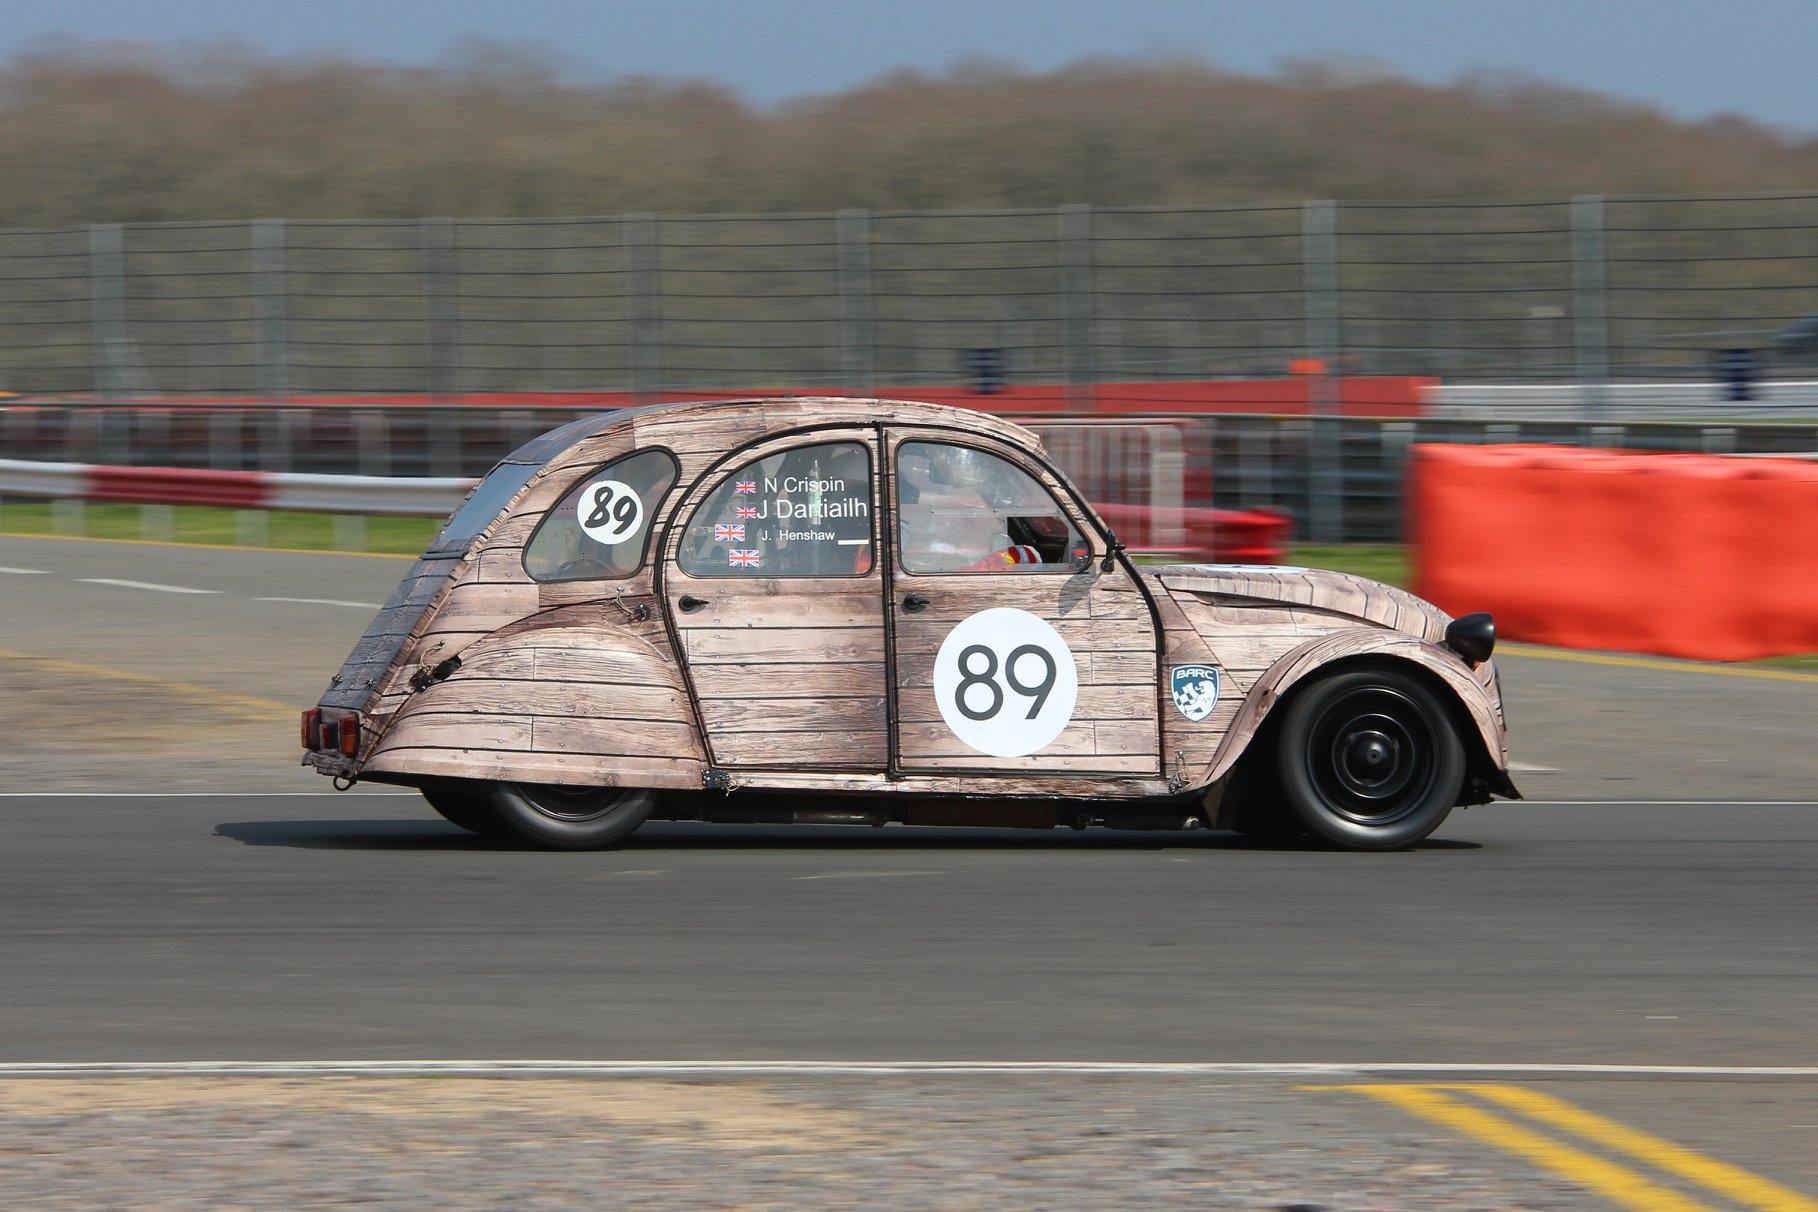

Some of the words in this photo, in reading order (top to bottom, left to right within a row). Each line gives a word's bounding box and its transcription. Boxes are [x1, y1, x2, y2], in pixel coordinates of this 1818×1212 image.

[764, 477, 778, 493] N
[783, 476, 845, 498] Crispin
[584, 486, 638, 535] 89
[757, 499, 768, 519] J
[776, 497, 868, 519] Dartiailh
[761, 530, 772, 541] J.
[779, 529, 835, 541] Henshaw
[955, 644, 1057, 721] 89
[1176, 668, 1215, 680] BARC
